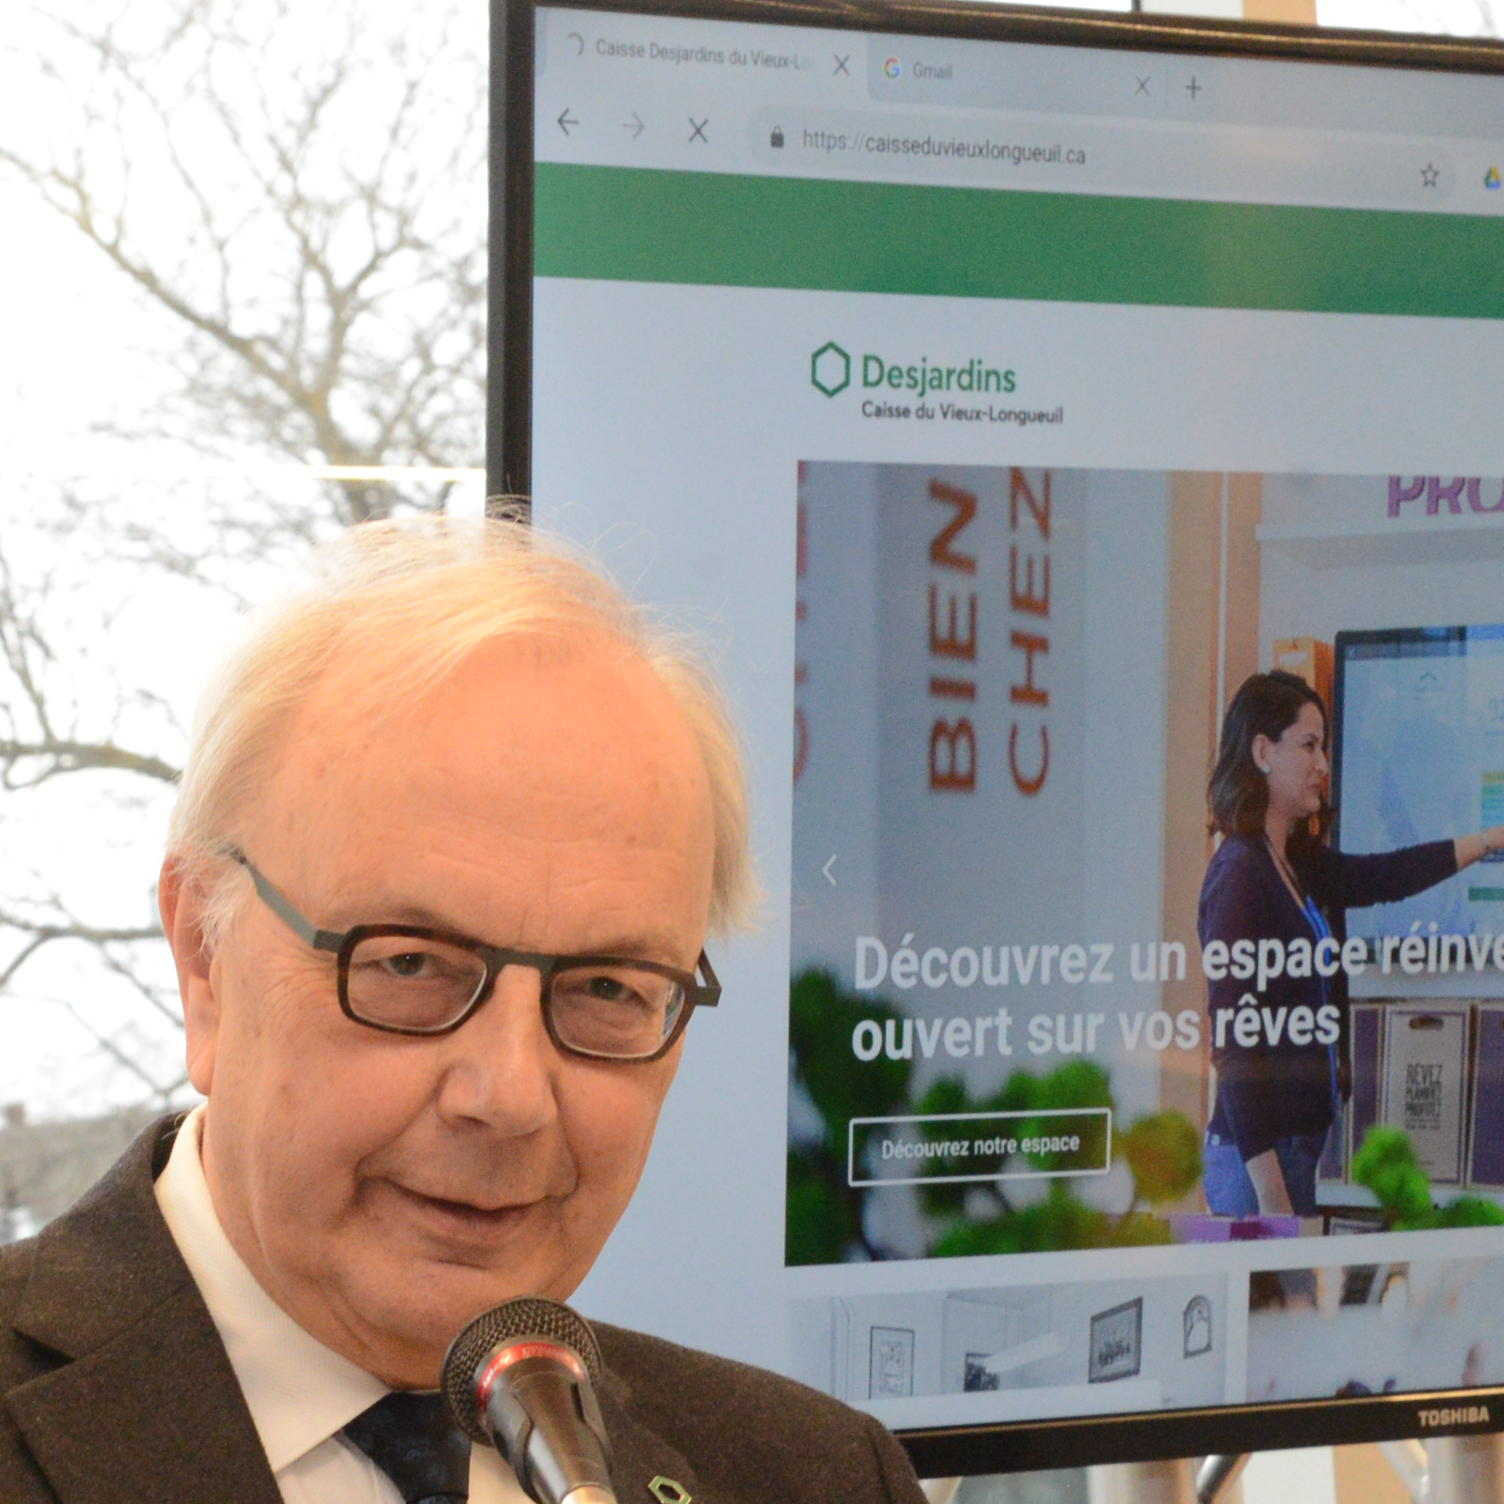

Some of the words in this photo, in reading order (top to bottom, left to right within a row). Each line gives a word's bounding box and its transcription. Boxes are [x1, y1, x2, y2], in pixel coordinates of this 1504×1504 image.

[595, 39, 645, 58] Caisse
[649, 42, 725, 66] Desjardins
[728, 51, 746, 67] du
[912, 61, 953, 81] Gmail
[802, 128, 1086, 166] https://caisseduvieuxlongueuil.ca
[862, 353, 1017, 398] Desjardins
[861, 400, 911, 419] Caisse
[915, 401, 935, 420] du
[939, 403, 1064, 427] Vieux-Longueuil
[928, 476, 977, 795] BIEN
[1008, 466, 1051, 797] CHEZ
[854, 932, 1114, 990] Découvrez
[1129, 939, 1186, 983] un
[1202, 936, 1368, 992] espace
[851, 1006, 1014, 1061] ouvert
[1026, 1011, 1105, 1055] sur
[1118, 1008, 1201, 1051] vos
[1215, 993, 1341, 1048] rêves
[882, 1137, 969, 1160] Découvrez
[974, 1136, 1017, 1156] notre
[1021, 1134, 1080, 1158] espace
[1417, 1405, 1490, 1427] TOSHIBA
